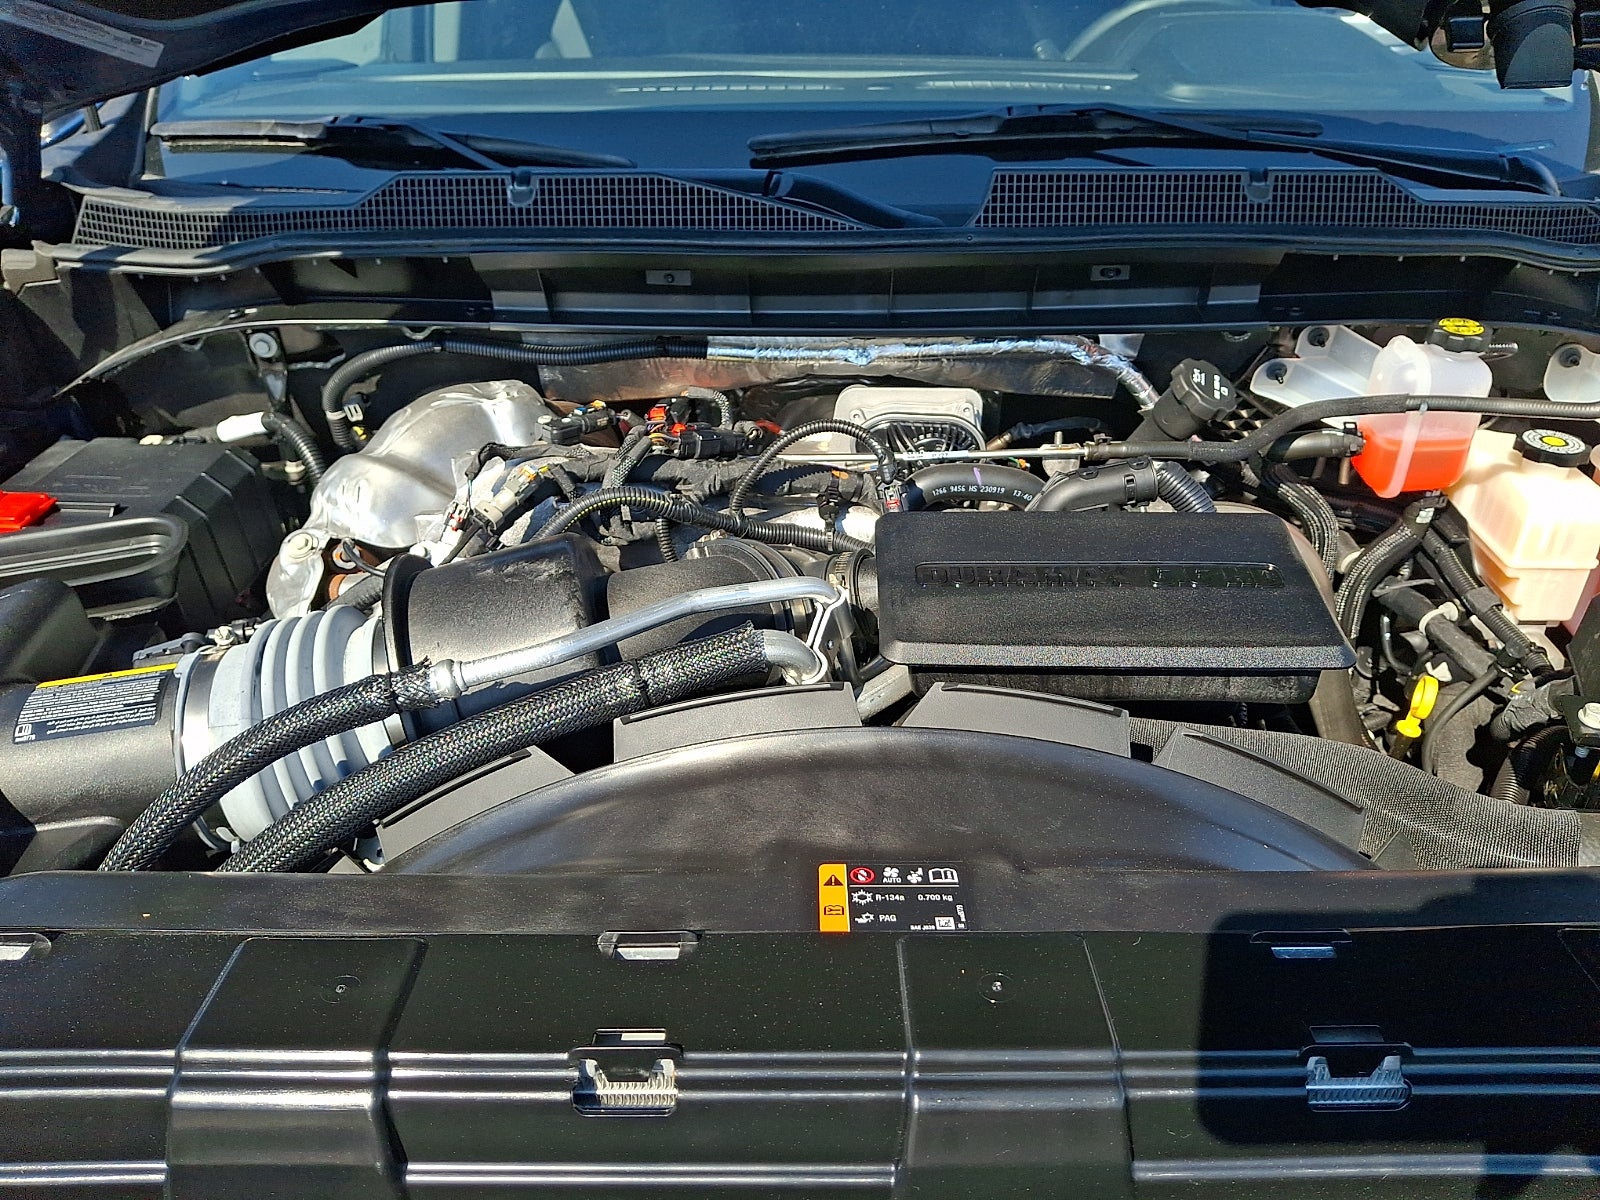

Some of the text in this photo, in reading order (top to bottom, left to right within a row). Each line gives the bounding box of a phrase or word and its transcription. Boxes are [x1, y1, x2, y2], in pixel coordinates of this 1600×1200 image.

[932, 486, 947, 497] 1266
[949, 485, 966, 493] 9456
[979, 486, 1005, 494] 230919
[1012, 489, 1033, 501] 13:40
[942, 893, 953, 902] kg
[879, 914, 897, 922] PAG
